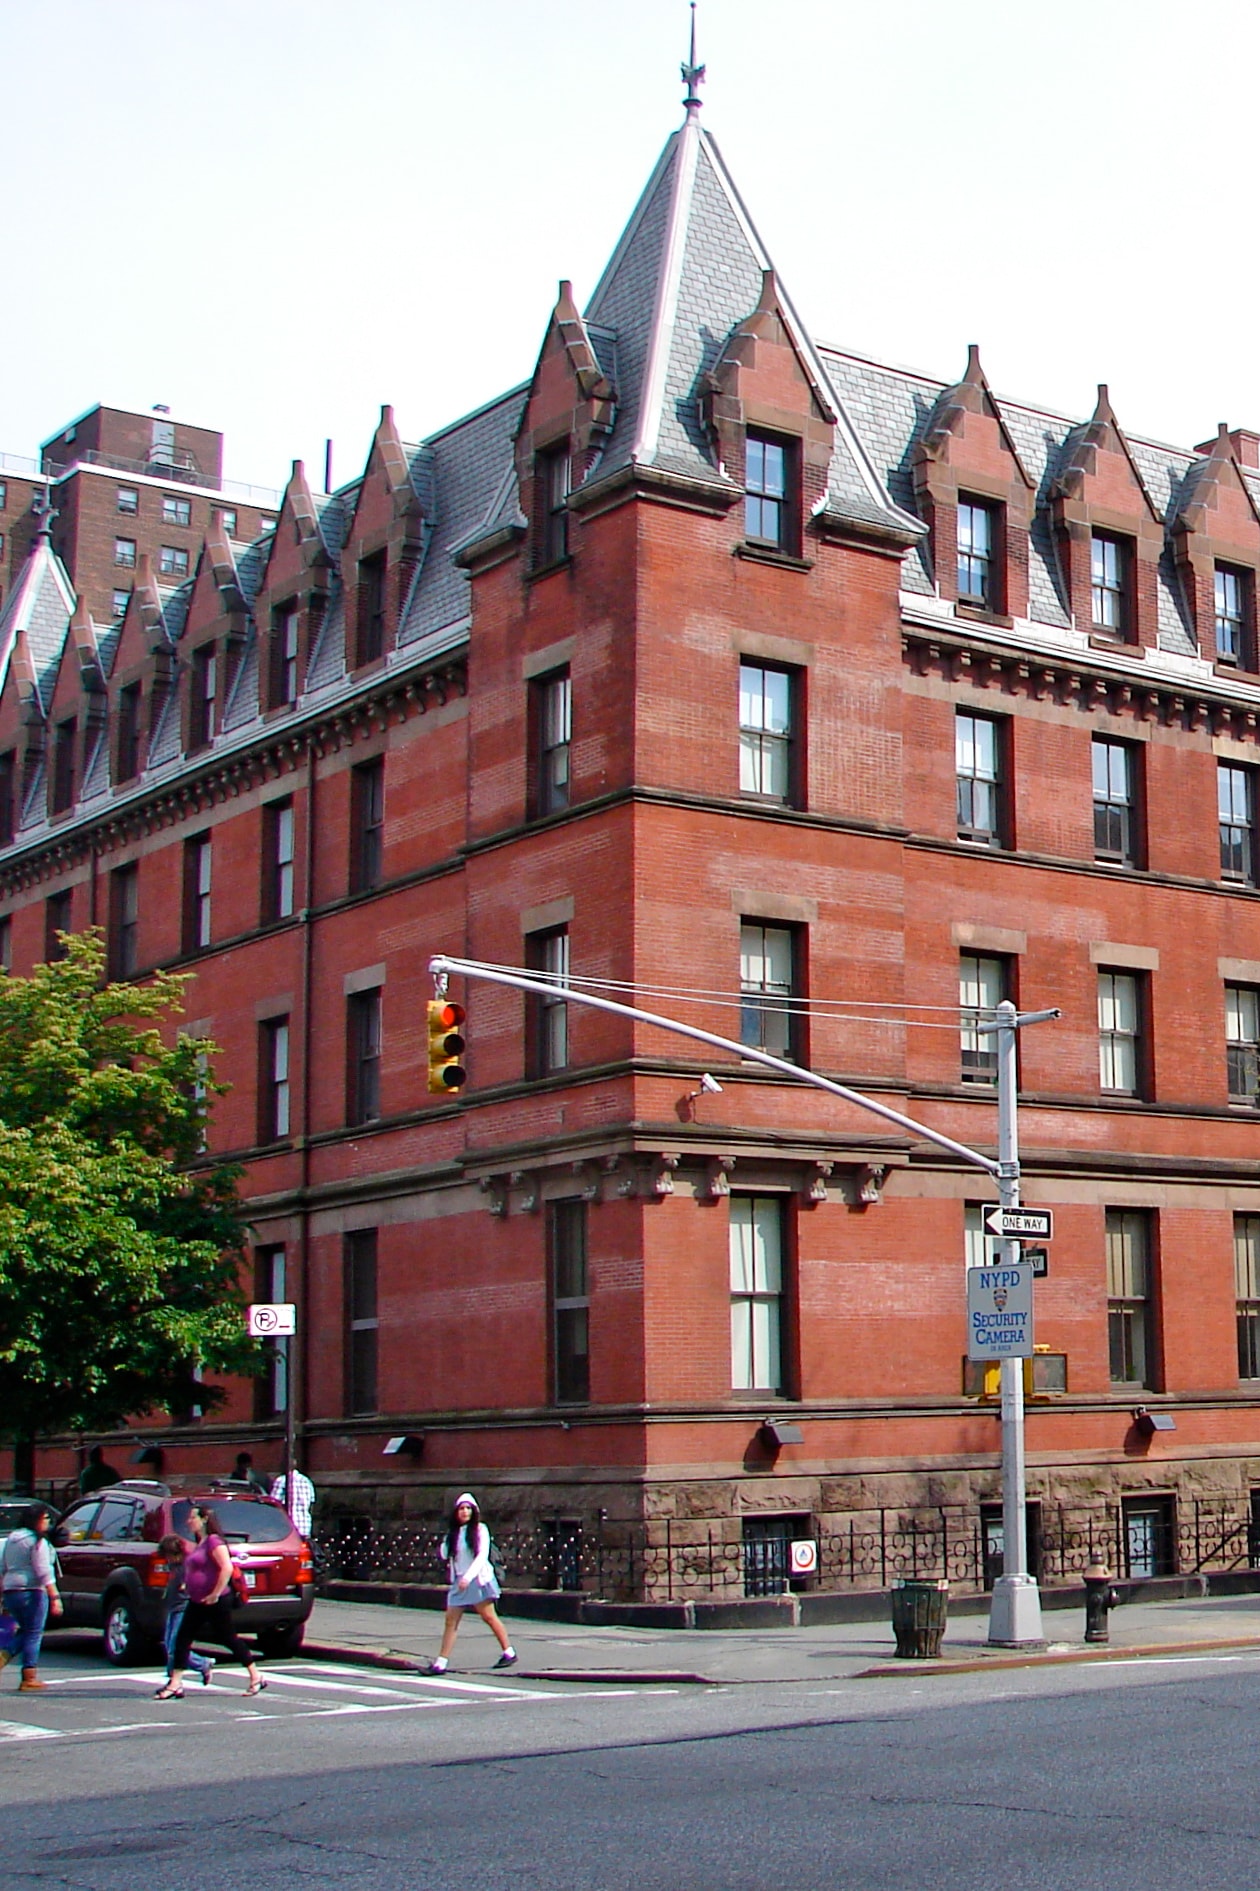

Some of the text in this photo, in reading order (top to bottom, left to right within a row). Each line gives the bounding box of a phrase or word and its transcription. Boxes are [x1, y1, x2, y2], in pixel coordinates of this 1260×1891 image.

[1002, 1216, 1043, 1230] ONE WAY
[980, 1270, 1020, 1289] NYPD
